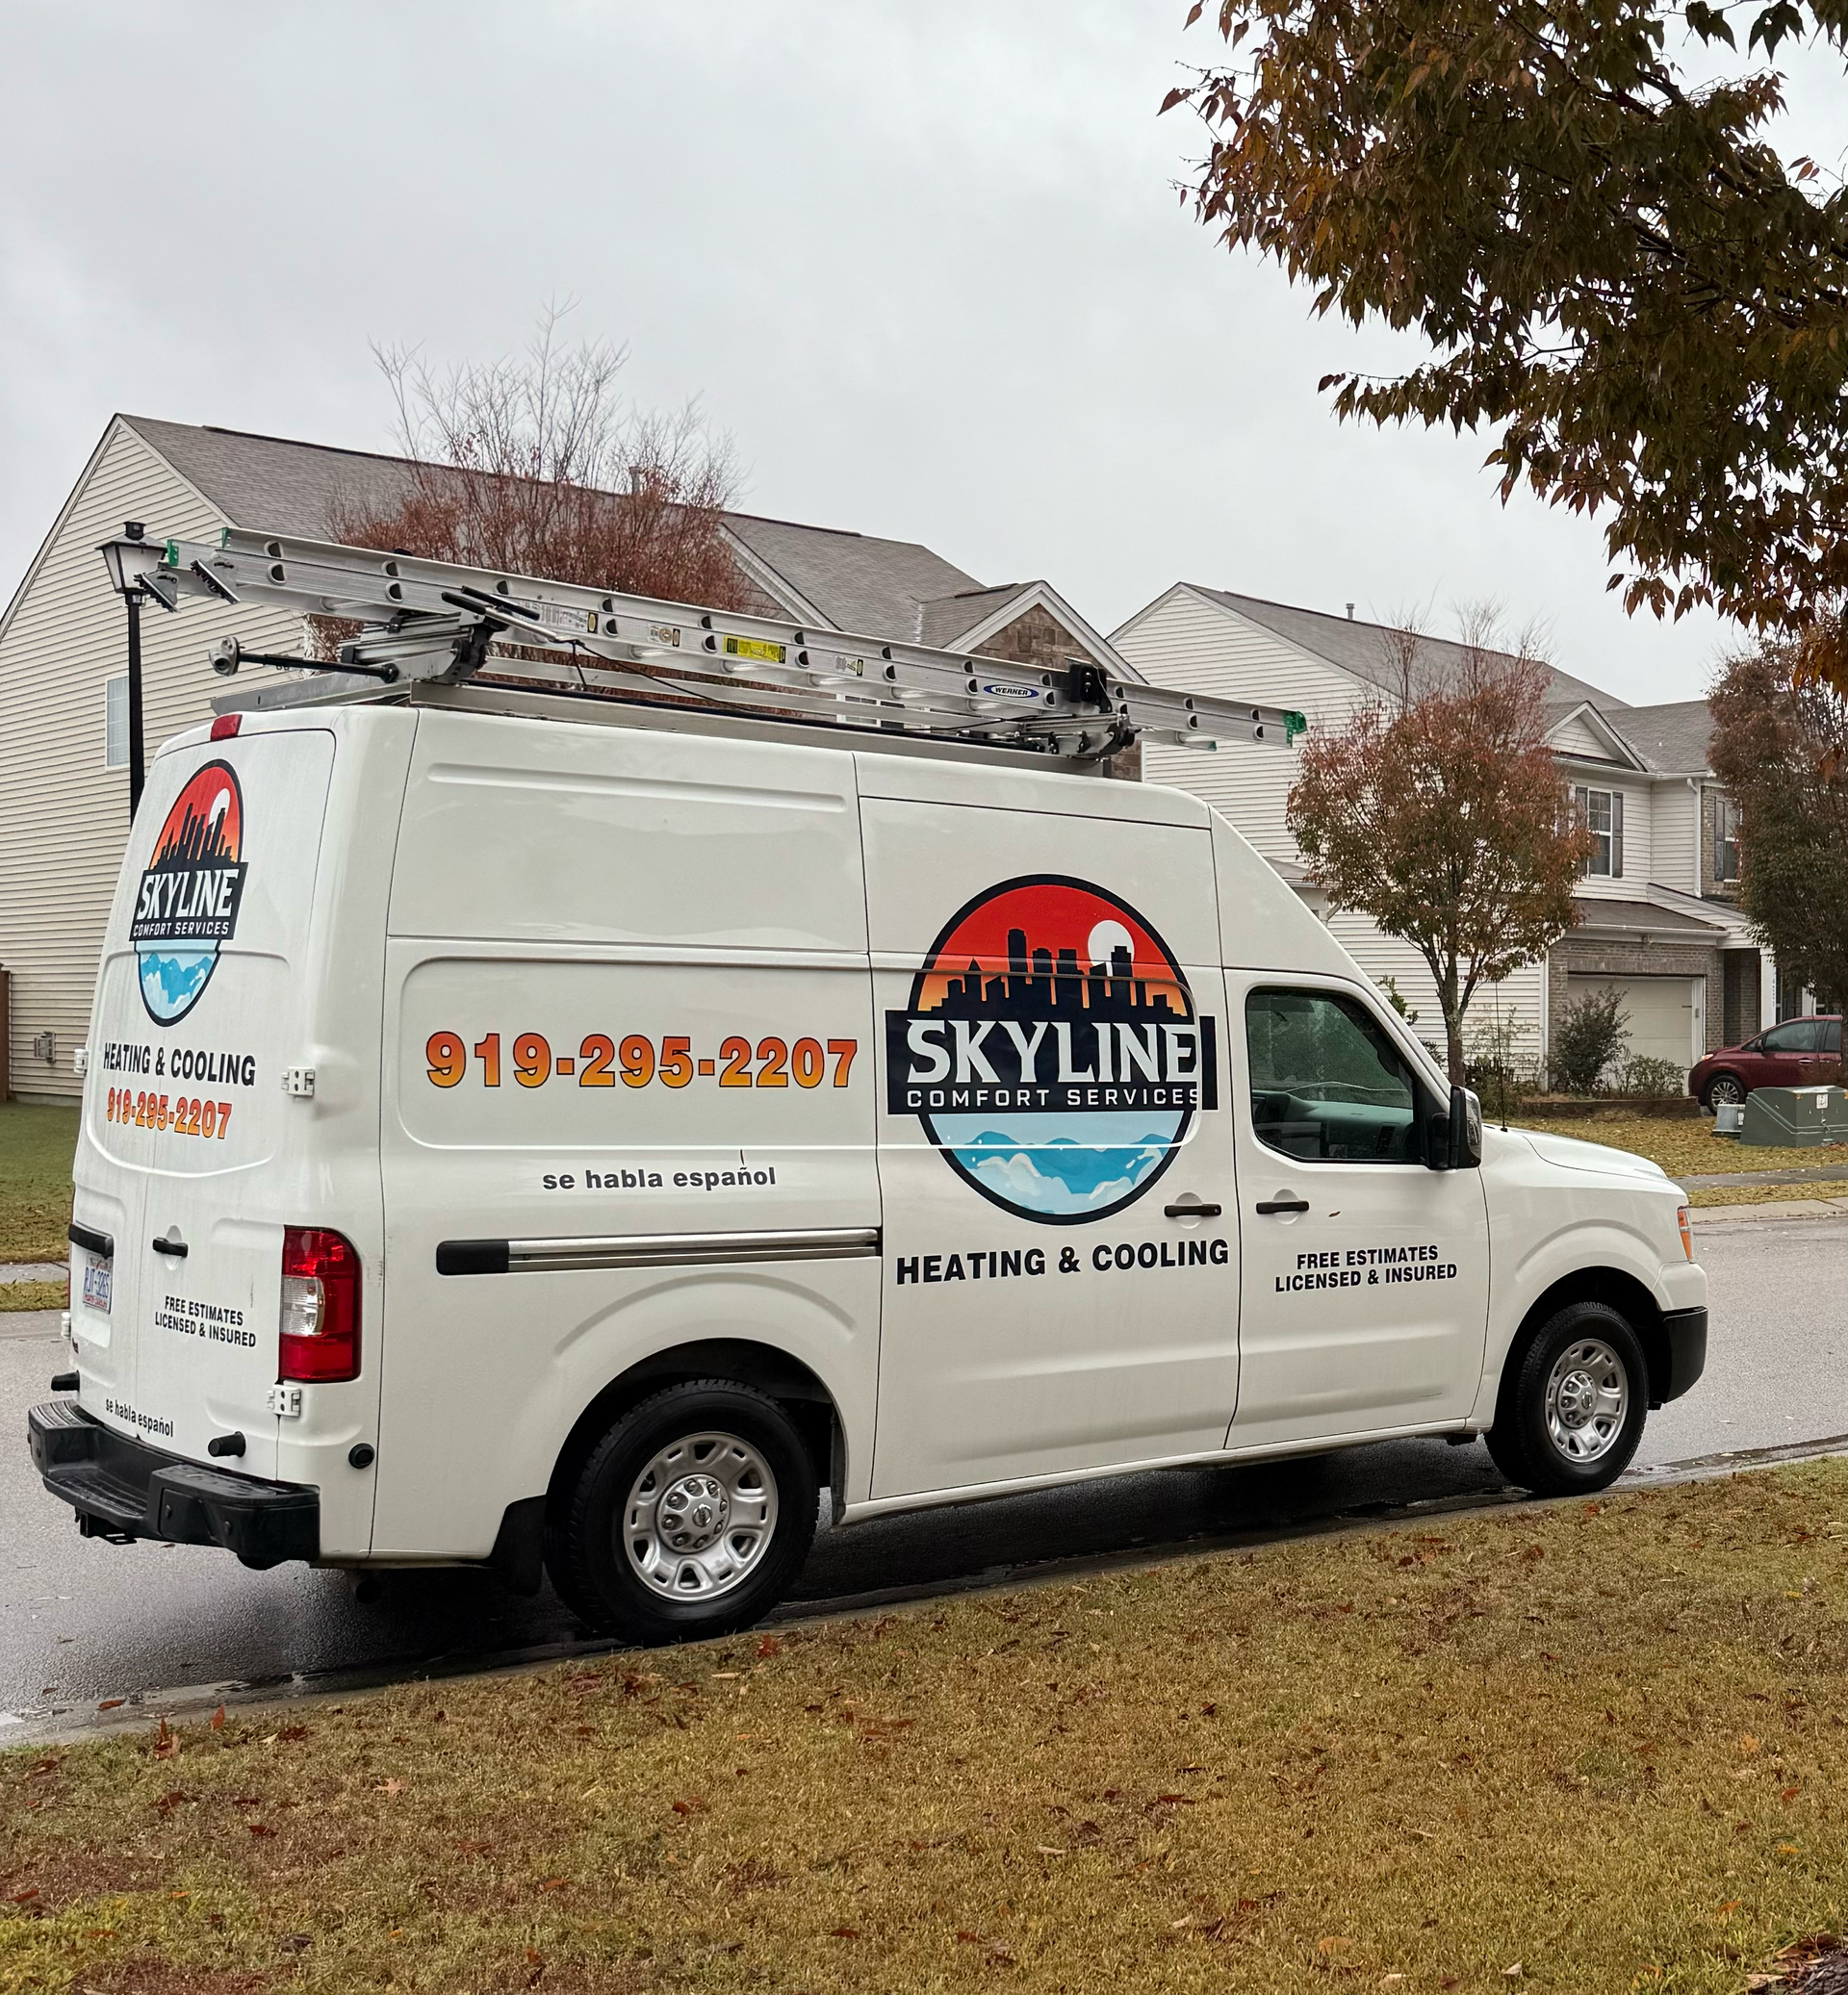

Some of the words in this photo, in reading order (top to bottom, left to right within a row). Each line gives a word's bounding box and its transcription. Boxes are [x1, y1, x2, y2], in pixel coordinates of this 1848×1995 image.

[136, 868, 240, 921] SKYLINE
[133, 922, 171, 937] COMFORT
[174, 921, 230, 936] SERVICES
[103, 1042, 151, 1074] HEATING
[155, 1046, 165, 1076] &
[170, 1048, 256, 1087] COOLING
[425, 1031, 858, 1089] 919-295-2207
[906, 1018, 1199, 1084] SKYLINE
[107, 1087, 232, 1139] 919-295-2207
[907, 1089, 1050, 1108] COMFORT
[1066, 1088, 1198, 1107] SERVICES
[542, 1173, 576, 1190] se
[585, 1168, 663, 1189] habla
[673, 1166, 777, 1191] español
[897, 1248, 1045, 1285] HEATING
[1058, 1246, 1081, 1274] &
[1091, 1239, 1228, 1272] COOLING
[1296, 1252, 1340, 1270] FREE
[1346, 1245, 1439, 1266] ESTIMATES
[1275, 1270, 1361, 1292] LICENSED
[1367, 1268, 1379, 1286] &
[1385, 1264, 1458, 1284] INSURED
[165, 1295, 187, 1314] FREE
[189, 1301, 244, 1326] ESTIMATES
[155, 1312, 196, 1335] LICENSED
[198, 1322, 206, 1338] &
[209, 1324, 256, 1347] INSURED
[106, 1398, 114, 1414] se
[115, 1399, 137, 1423] habla
[138, 1414, 173, 1438] español
